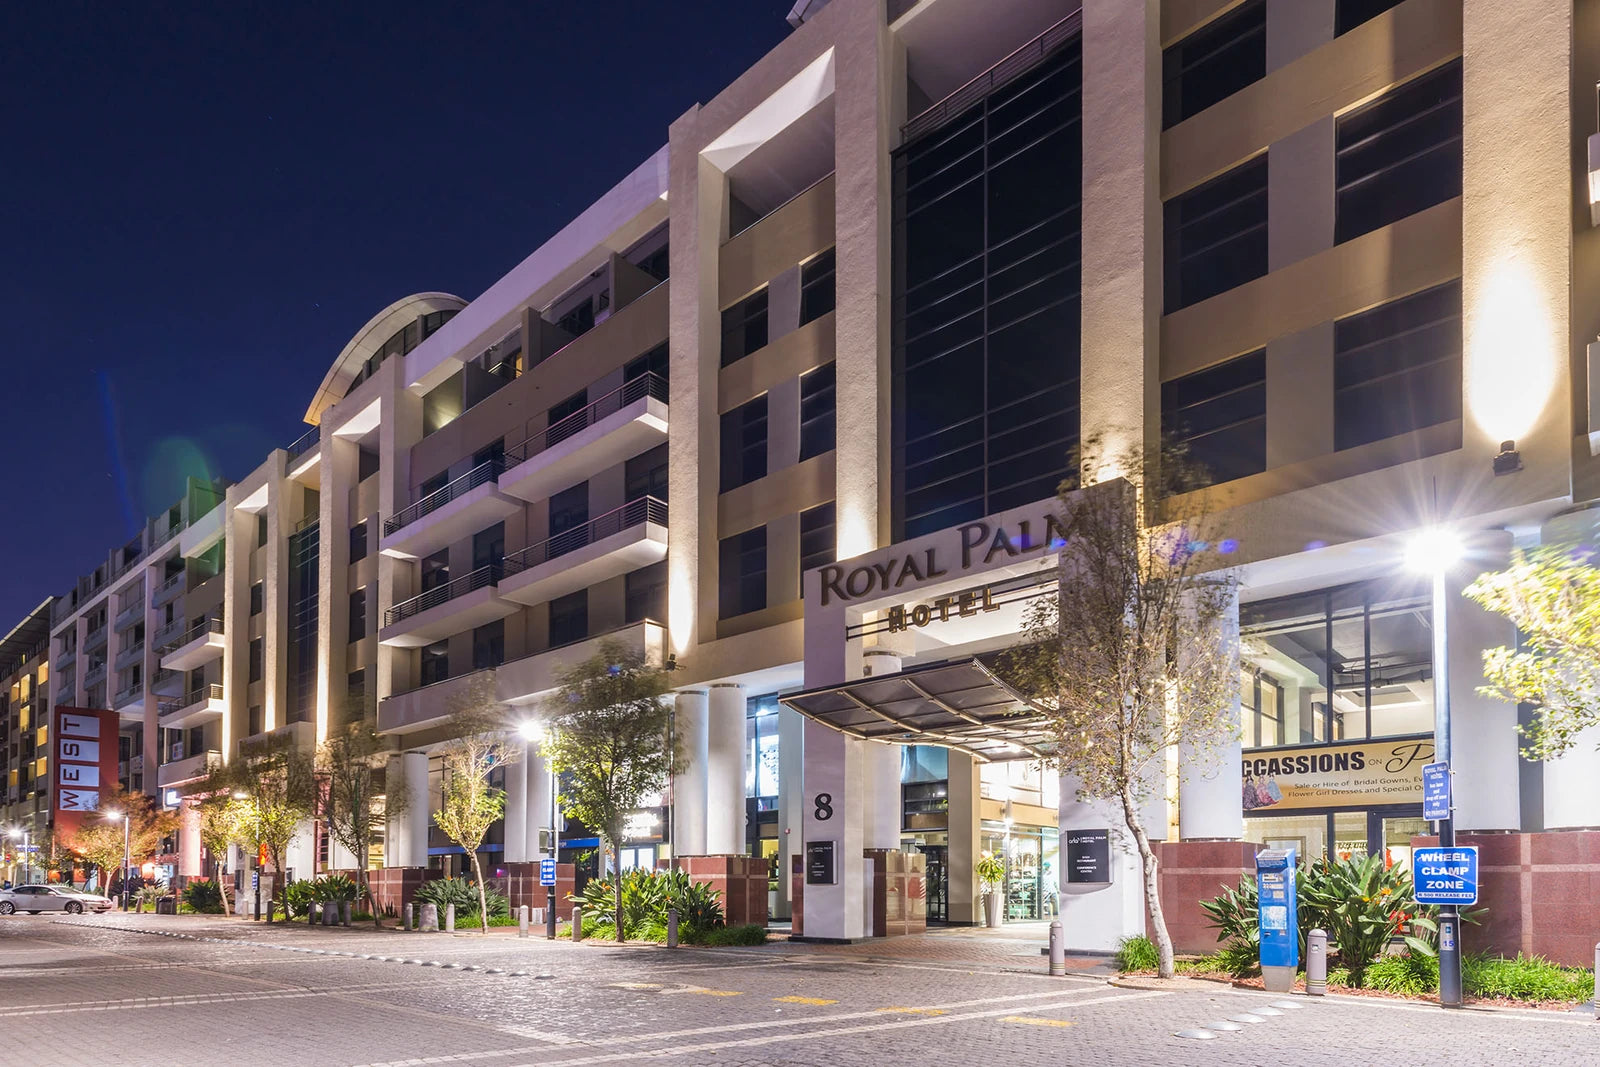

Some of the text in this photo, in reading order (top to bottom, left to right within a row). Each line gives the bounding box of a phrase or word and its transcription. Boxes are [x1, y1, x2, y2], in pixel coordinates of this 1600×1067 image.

[818, 548, 948, 607] ROYAL
[888, 587, 1000, 633] HOTEL
[62, 717, 80, 809] WEST
[1368, 758, 1382, 766] ON
[1385, 743, 1435, 773] P
[1383, 785, 1412, 793] Special
[814, 793, 833, 821] 8
[1421, 853, 1470, 862] WHEEL
[1421, 866, 1469, 876] CLAMP
[1426, 880, 1464, 889] ZONE
